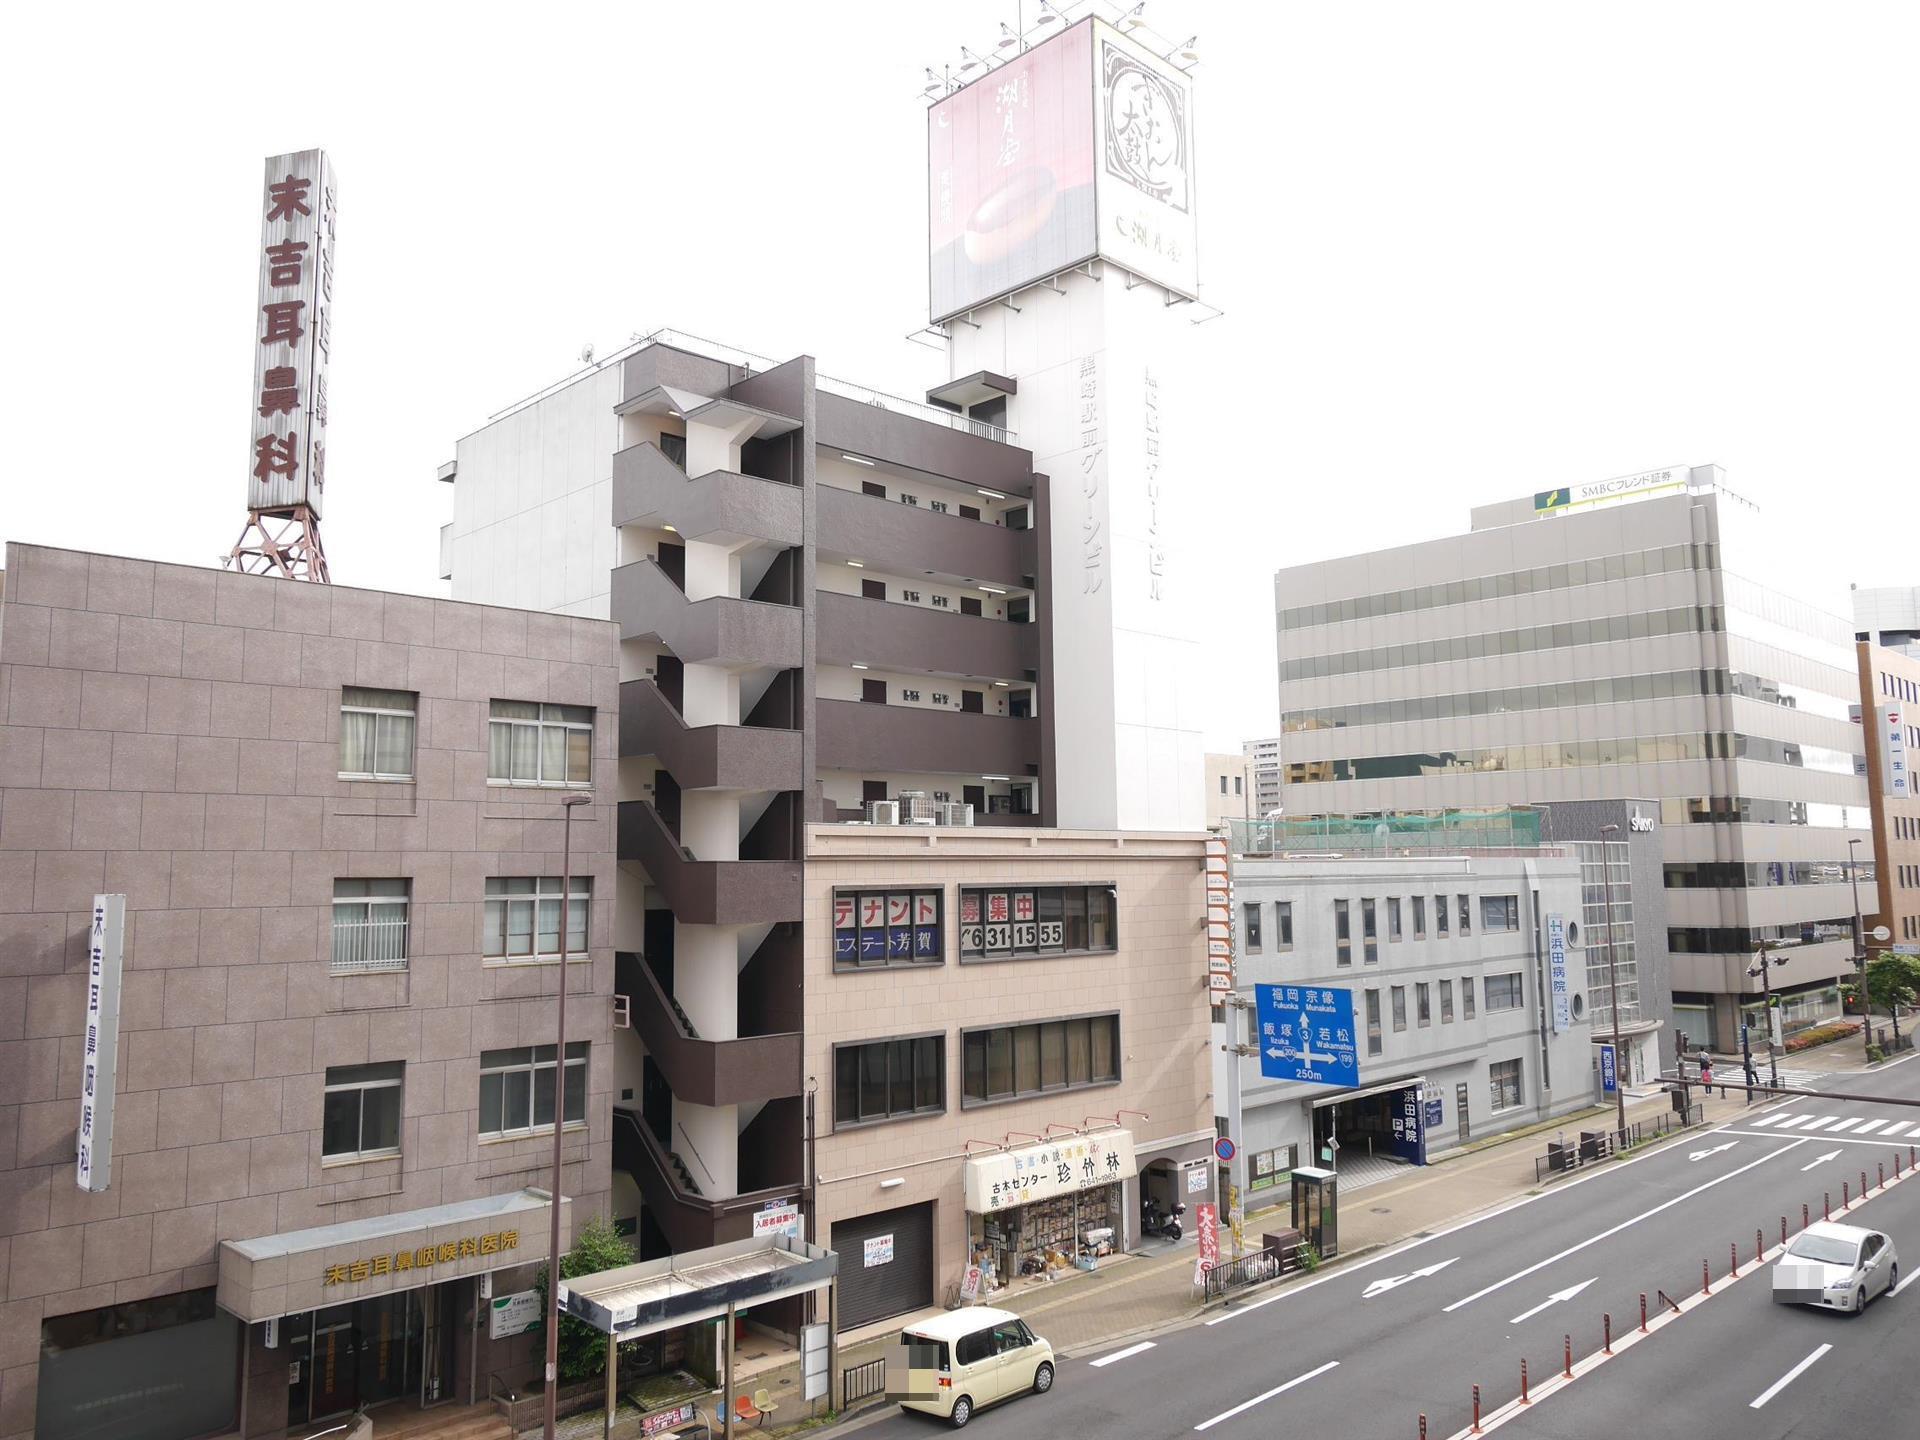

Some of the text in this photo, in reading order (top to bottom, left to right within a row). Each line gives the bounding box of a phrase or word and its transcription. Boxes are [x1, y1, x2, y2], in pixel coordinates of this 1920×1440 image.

[253, 174, 312, 484] 末吉耳鼻科
[1581, 470, 1672, 498] SMBCフレンド証券
[835, 894, 1033, 926] テナント 募集中
[1551, 937, 1566, 993] 浜田病院
[1272, 987, 1335, 1004] 福岡 宗像
[1273, 1001, 1337, 1013] Fukuoka Munakata
[1263, 1022, 1293, 1036] 飯塚
[1302, 1030, 1309, 1040] 3
[1319, 1027, 1350, 1042] 若松
[1316, 1041, 1354, 1051] Wakamatsu
[1296, 1069, 1322, 1080] 250m
[1403, 1090, 1418, 1143] 浜田病院
[1057, 1151, 1120, 1184] 珍竹林
[325, 1229, 520, 1286] 末吉耳鼻咽喉科医院
